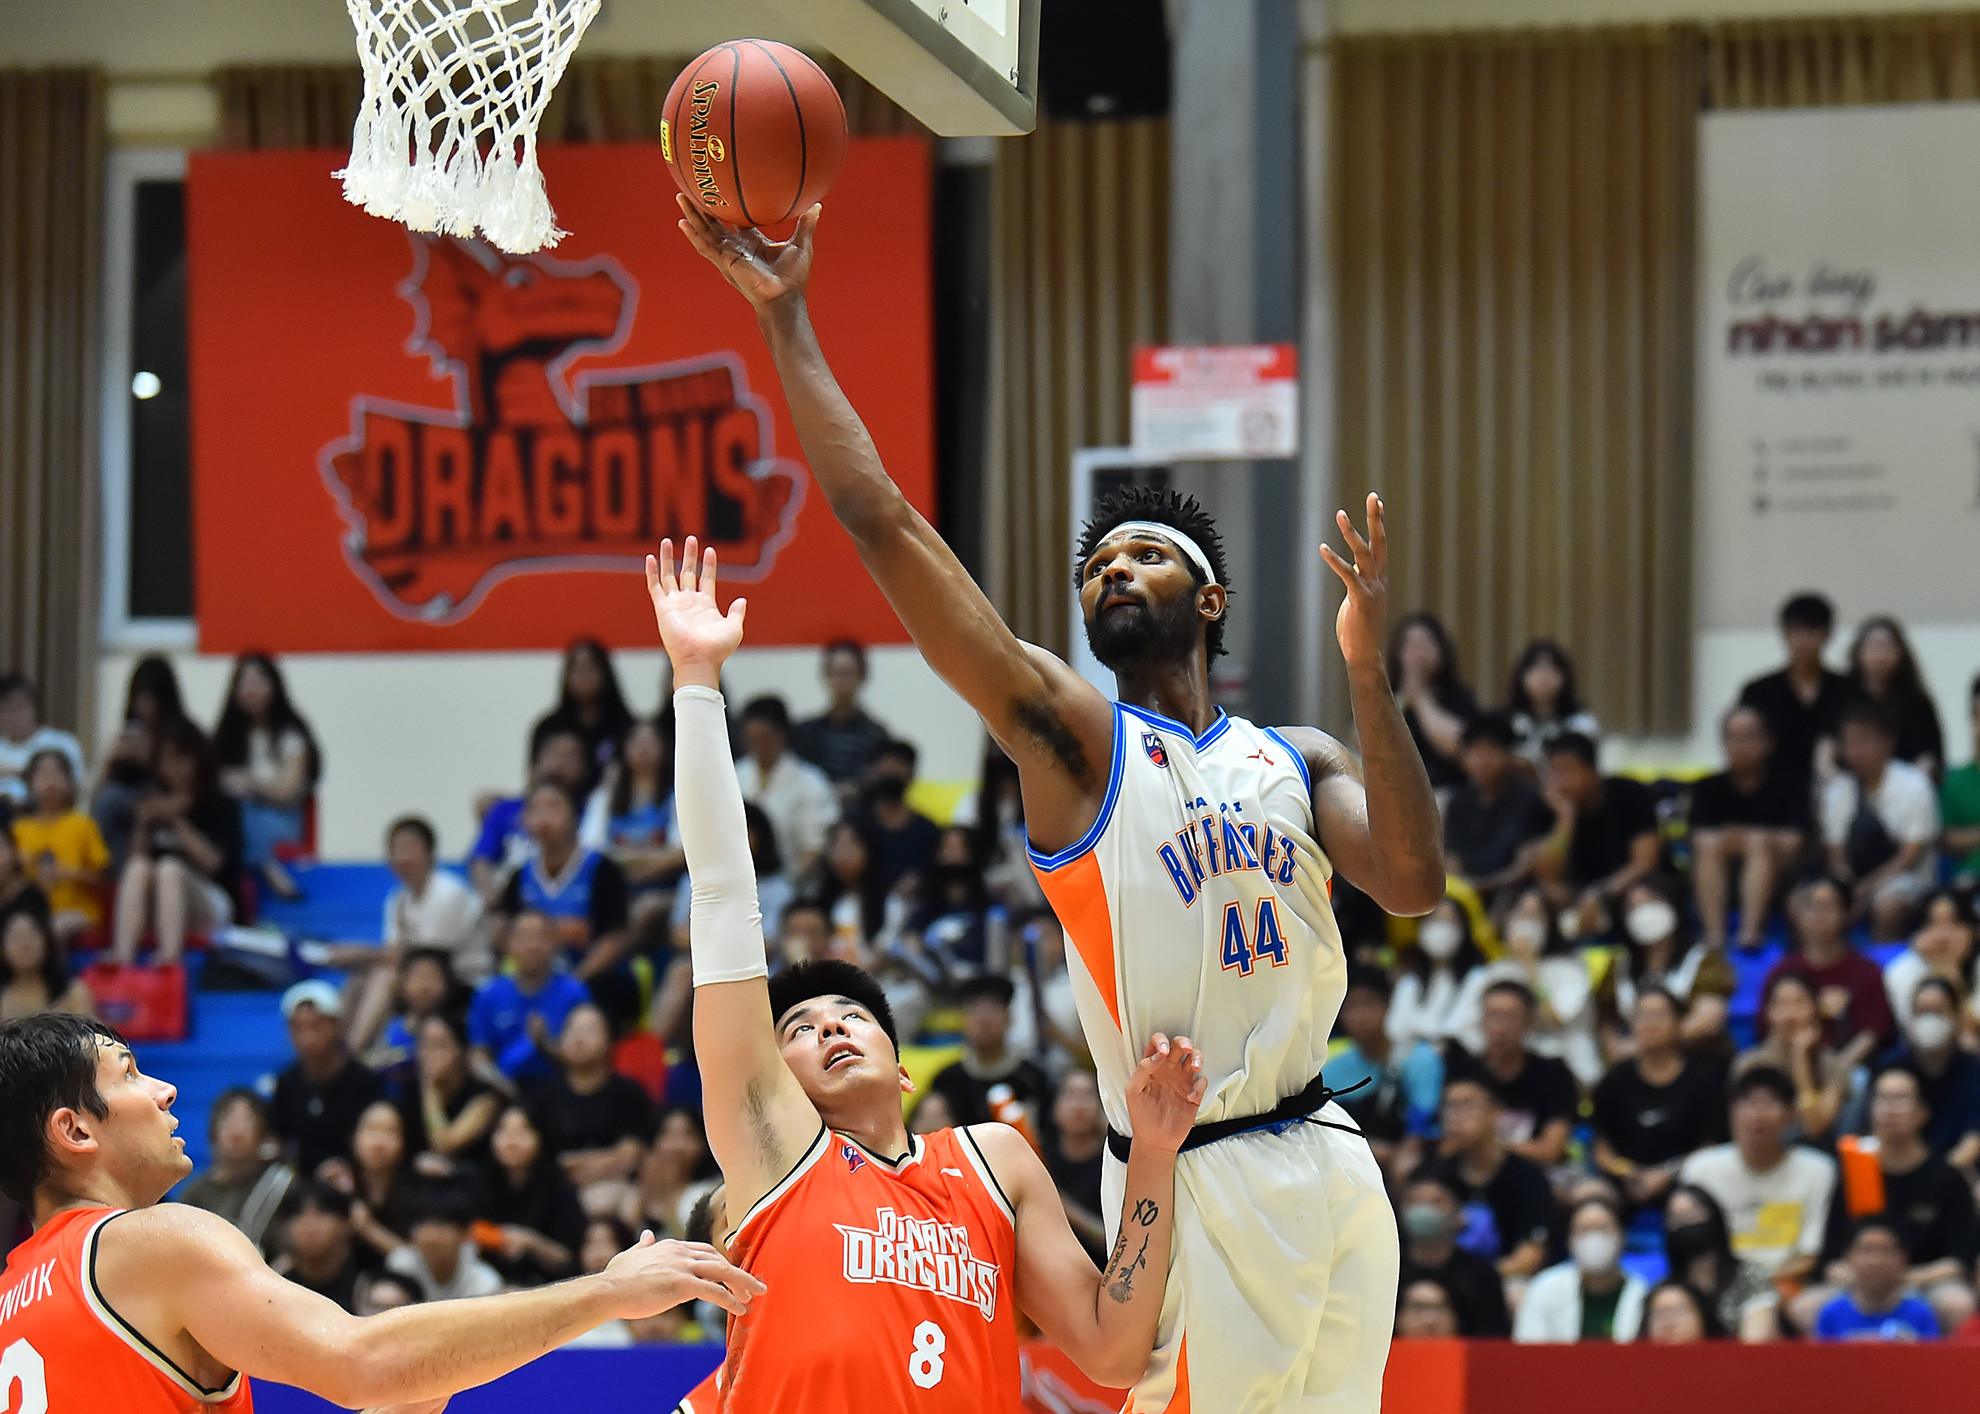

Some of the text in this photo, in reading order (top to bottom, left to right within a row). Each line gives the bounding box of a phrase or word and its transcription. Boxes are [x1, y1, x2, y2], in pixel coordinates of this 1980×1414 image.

[690, 80, 730, 207] SPALDING
[365, 406, 762, 546] DRAGONS
[1219, 896, 1289, 977] 44
[845, 1231, 996, 1318] DRAGONS
[909, 1320, 946, 1390] 8
